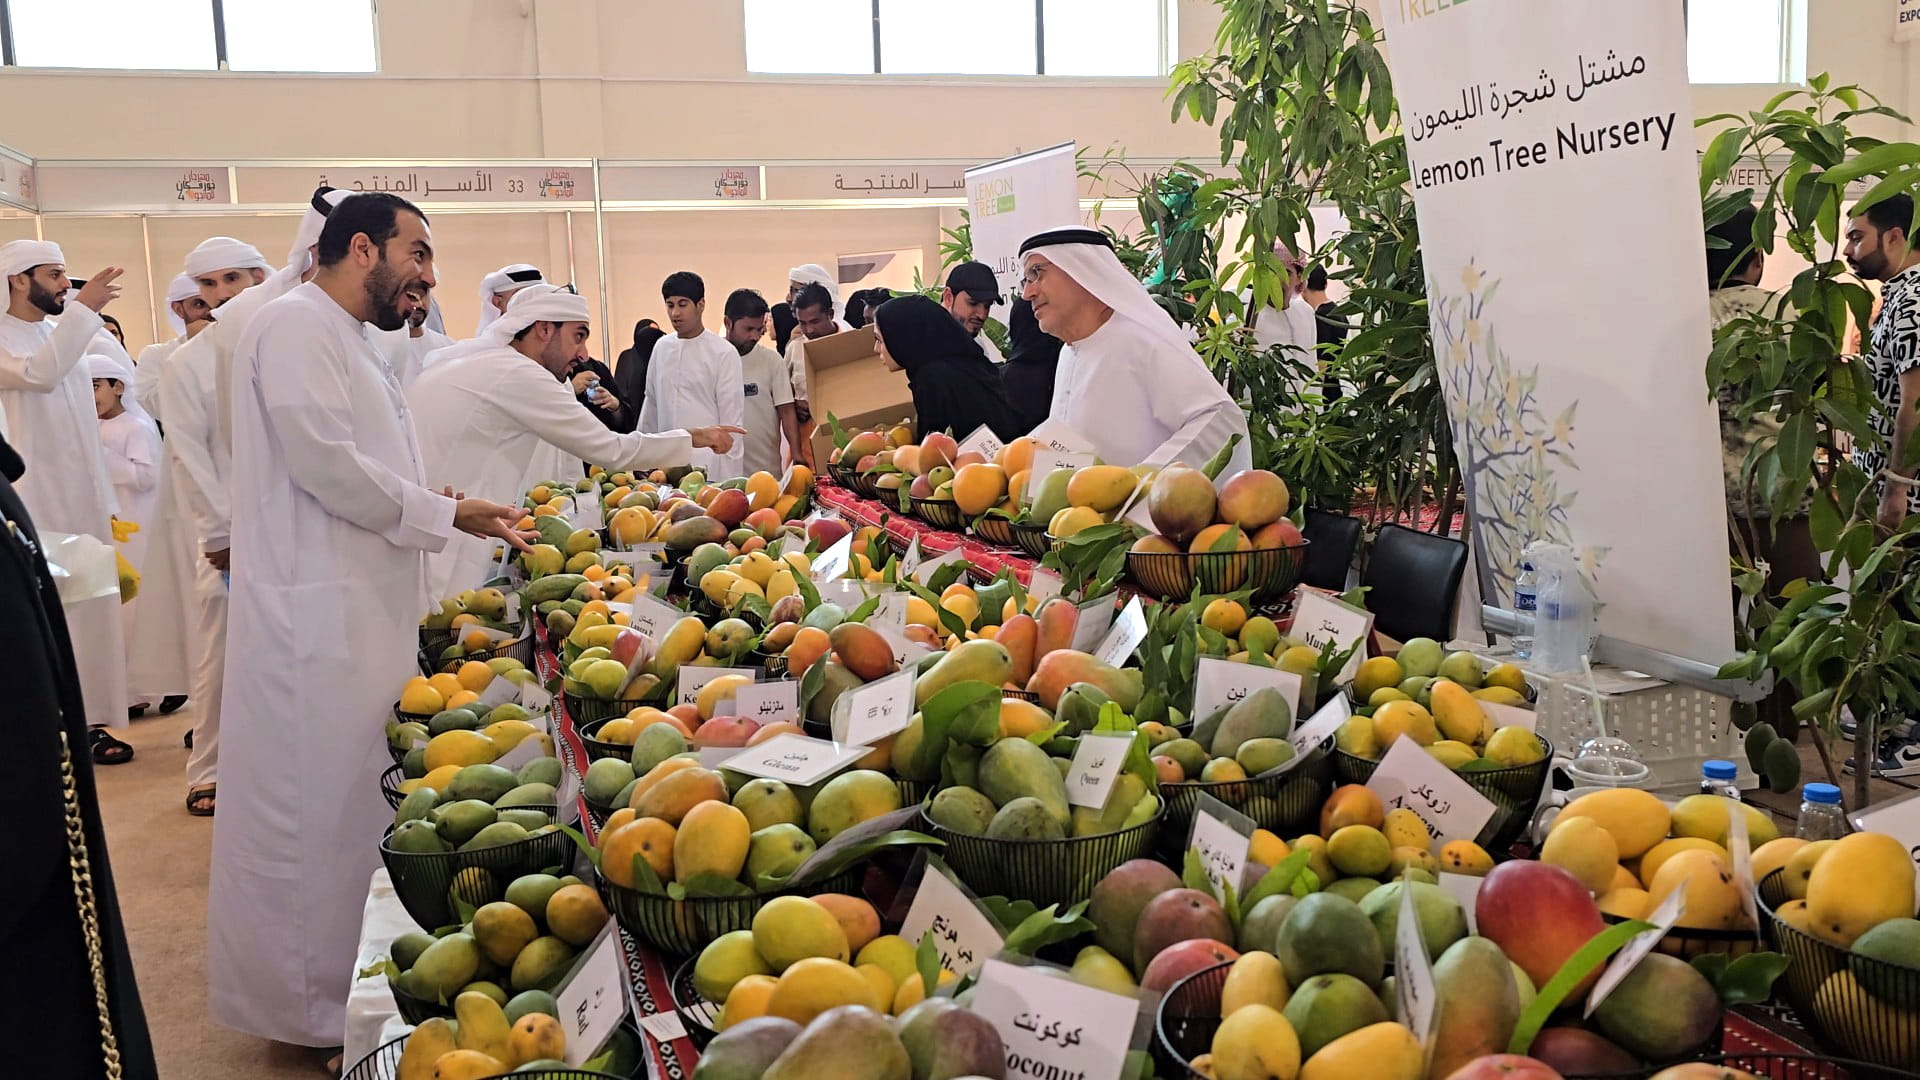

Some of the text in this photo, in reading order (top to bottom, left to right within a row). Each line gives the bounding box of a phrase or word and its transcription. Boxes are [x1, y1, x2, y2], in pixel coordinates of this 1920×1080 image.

[1410, 49, 1646, 142] مشتل شجرة الليمون
[1412, 112, 1676, 189] Lemon Tree Nursery
[424, 169, 493, 197] الأسر
[507, 179, 525, 193] 33
[834, 172, 919, 195] المنتجة
[974, 175, 1015, 201] LEMON
[974, 198, 997, 219] TREE
[1013, 1012, 1083, 1048] كوكونت
